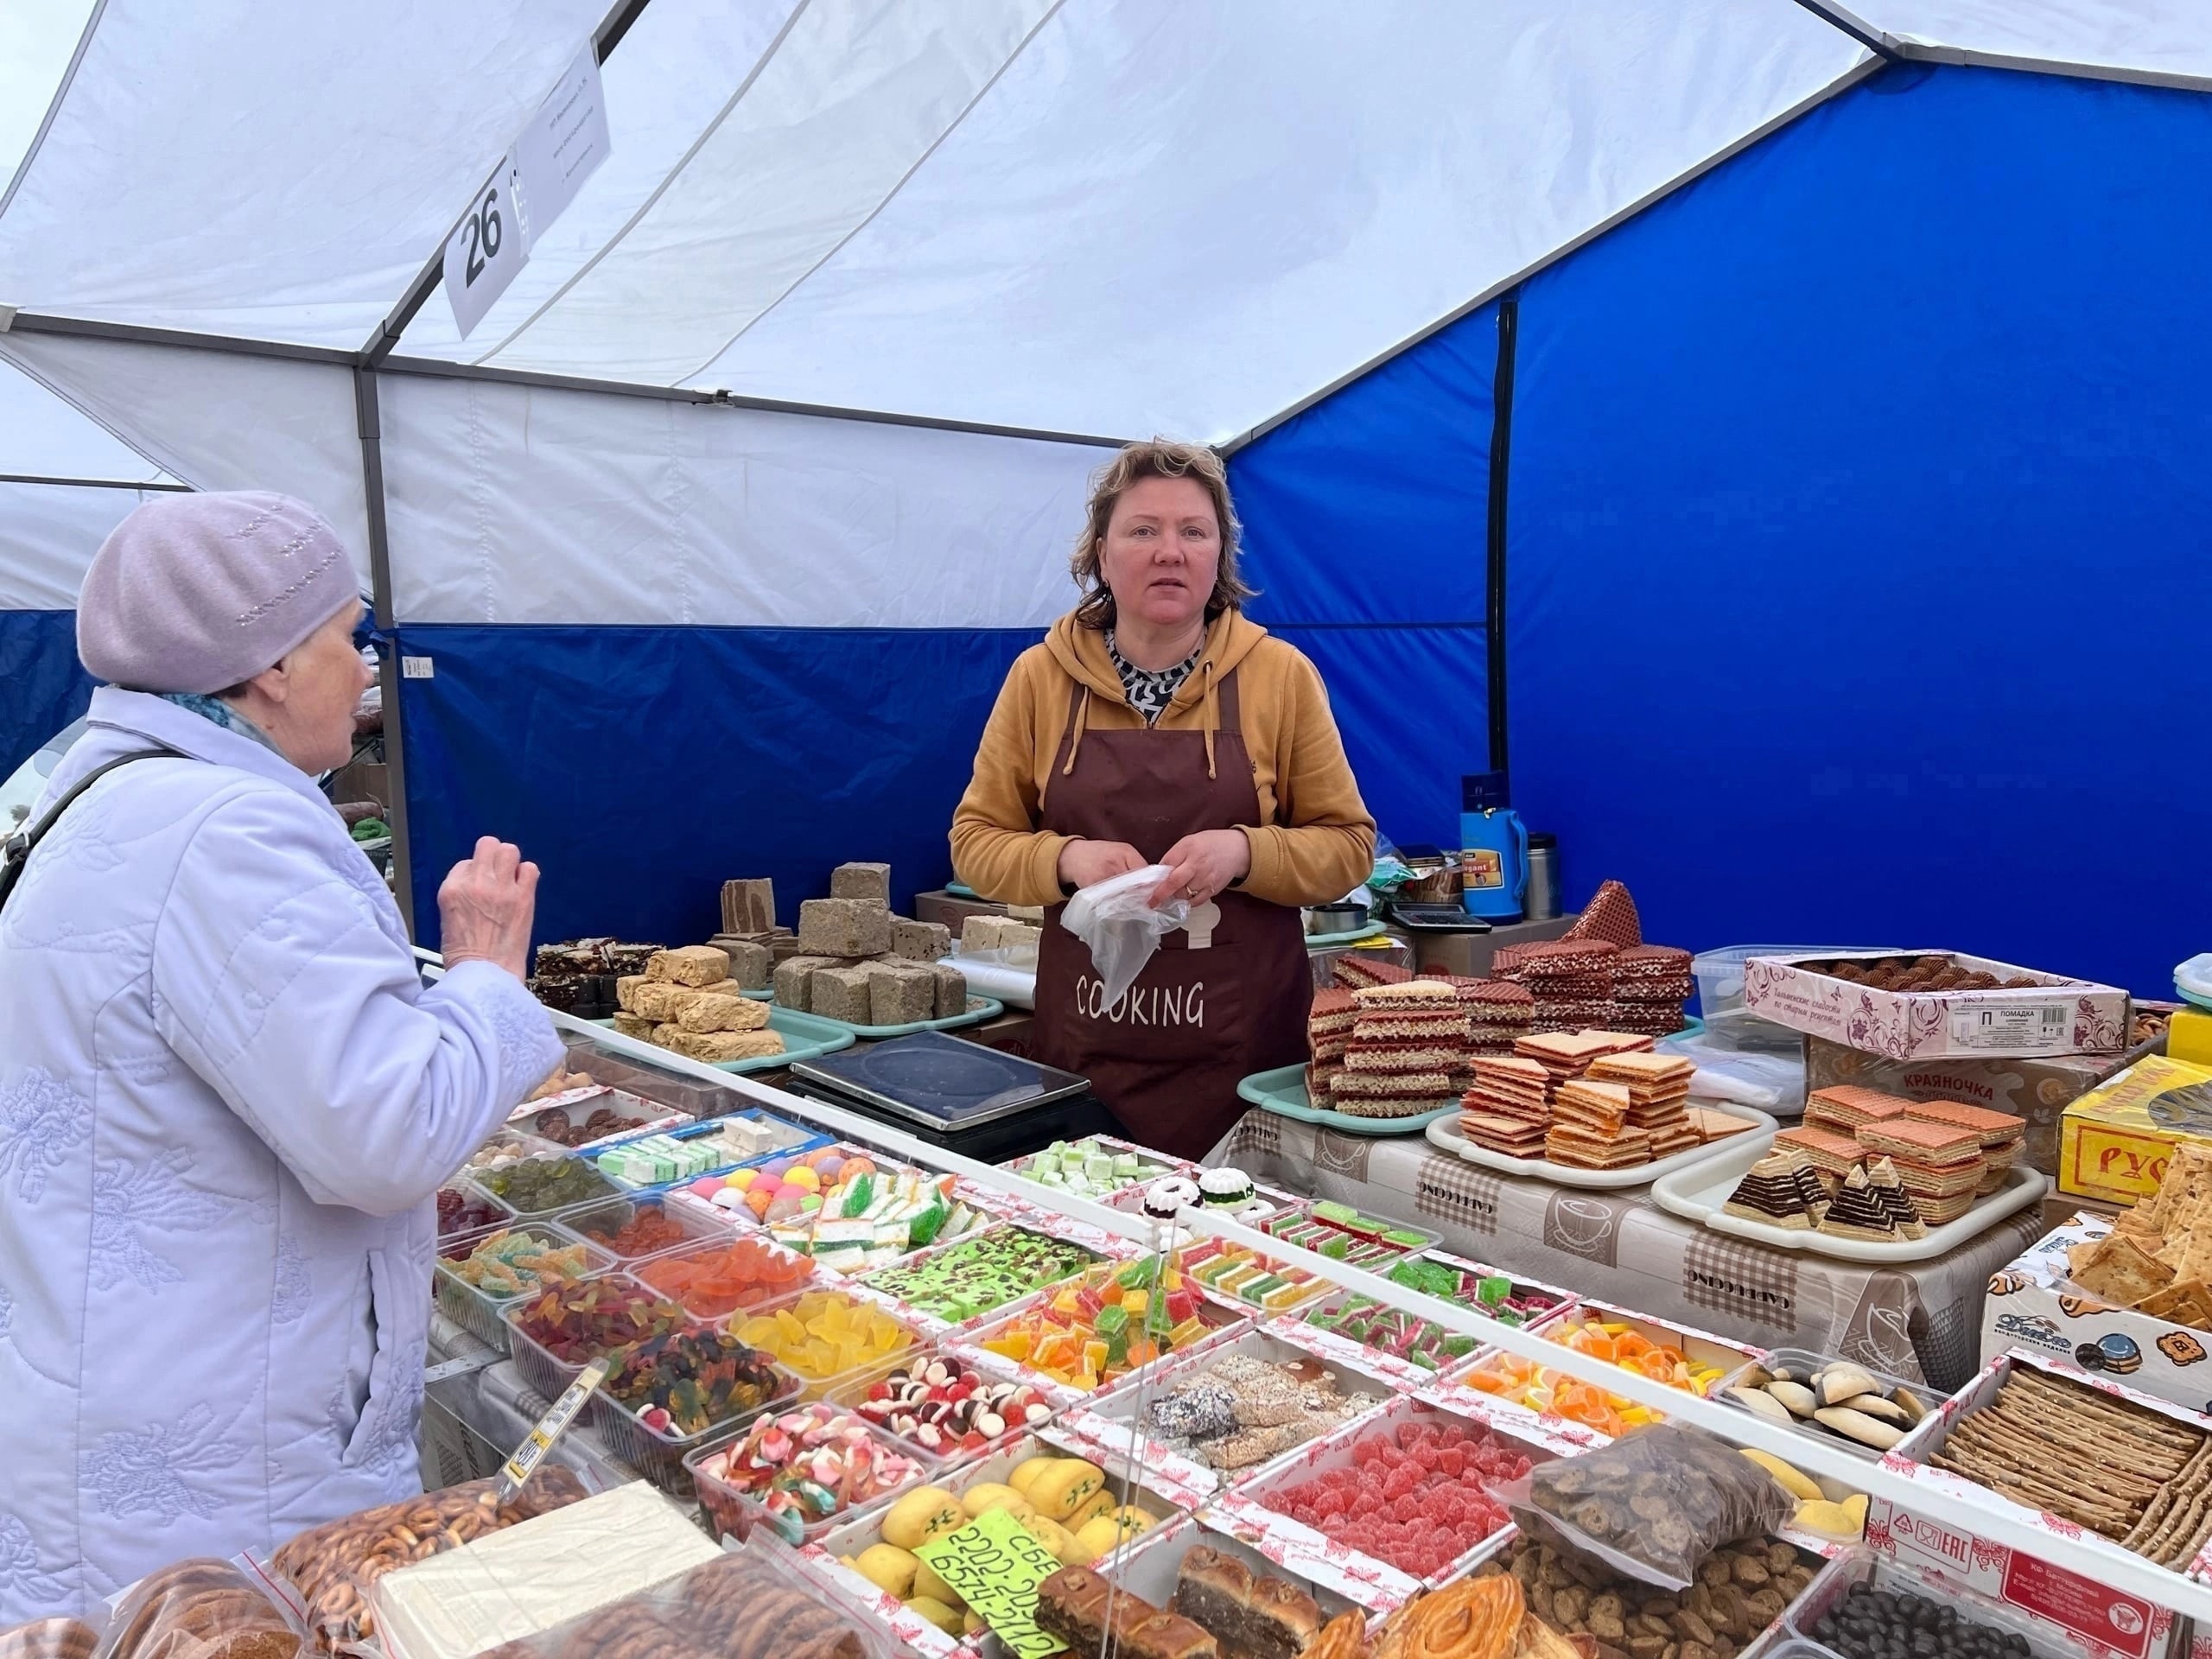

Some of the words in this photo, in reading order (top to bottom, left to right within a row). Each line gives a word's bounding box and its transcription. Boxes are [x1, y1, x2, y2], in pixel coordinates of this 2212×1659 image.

[461, 188, 502, 289] 26
[1076, 975, 1204, 1028] COOKING
[1812, 1000, 1841, 1014] сладости
[1981, 1012, 1992, 1026] П
[1904, 1074, 1993, 1101] КРАЯНОЧКА
[2098, 1147, 2170, 1185] РУС
[1419, 1182, 1493, 1214] CAPPUCCINO
[1688, 1269, 1789, 1309] CAPPUCCINO
[1009, 1535, 1064, 1574] СБЕ
[1942, 1532, 1969, 1563] EAC
[948, 1526, 1039, 1620] 2202.20
